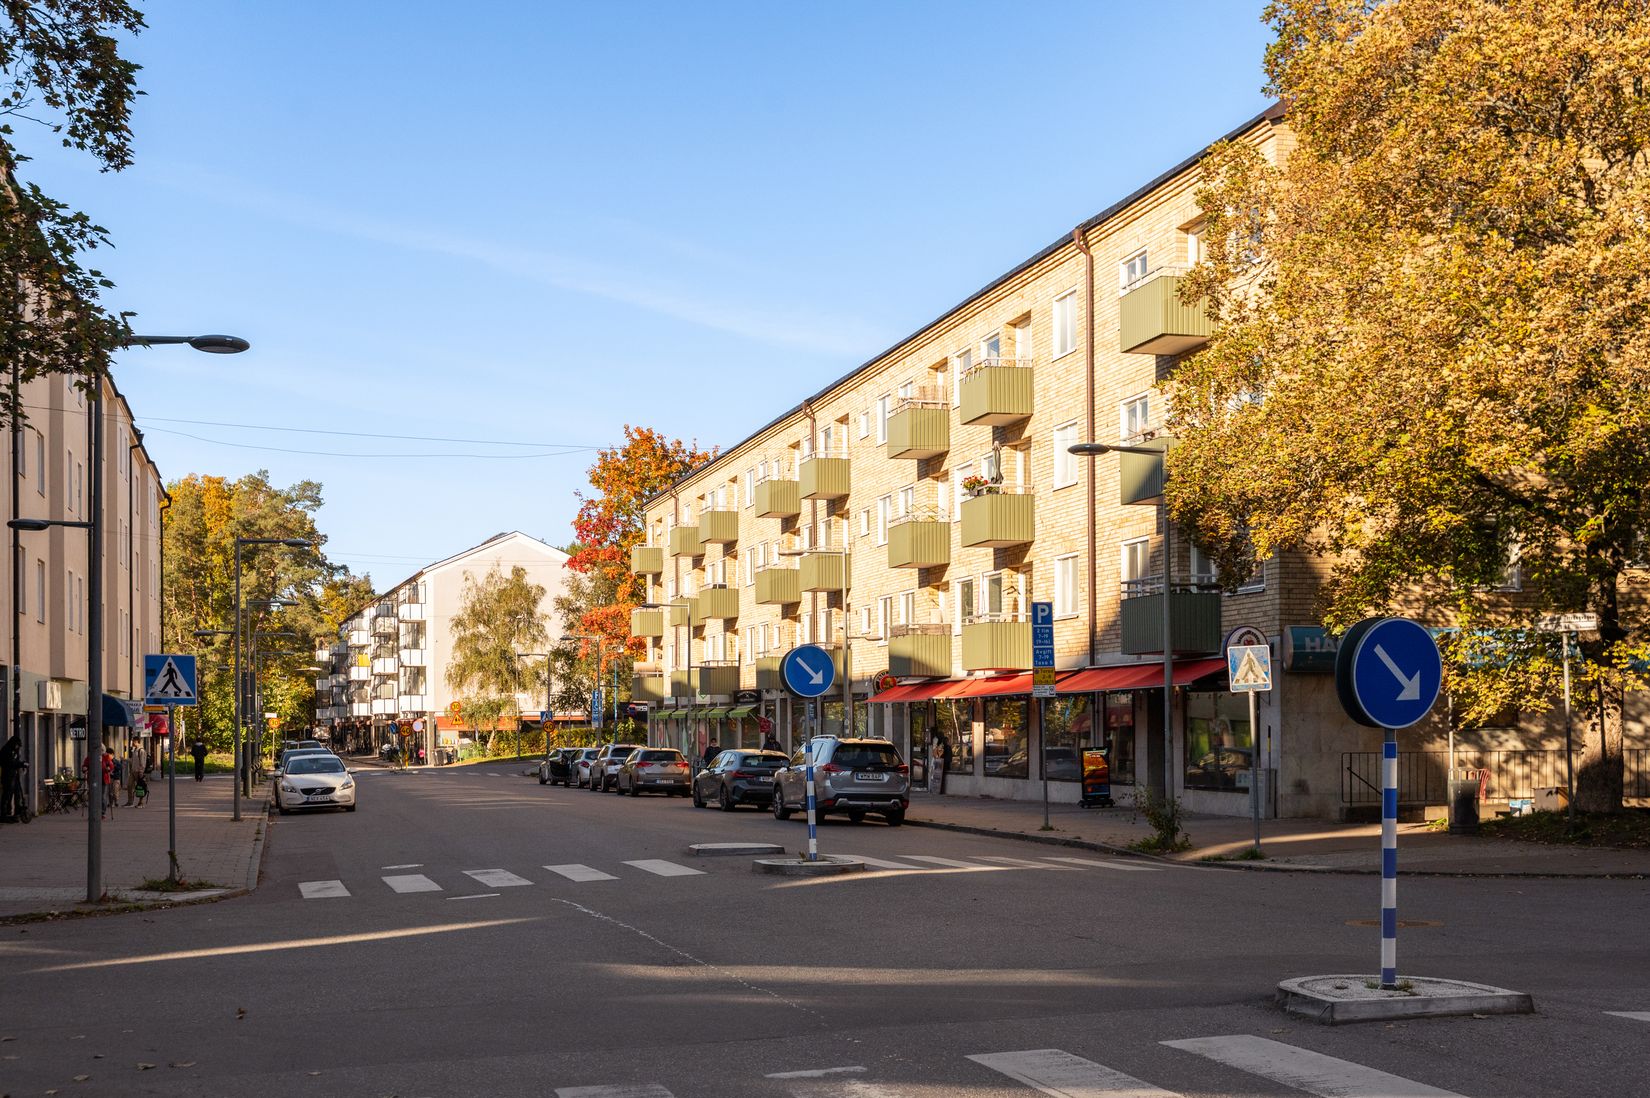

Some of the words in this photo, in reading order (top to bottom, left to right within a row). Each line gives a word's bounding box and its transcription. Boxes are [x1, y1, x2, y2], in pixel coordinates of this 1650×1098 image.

[1037, 604, 1050, 624] P
[1305, 637, 1342, 652] HA
[70, 727, 86, 739] RETRO
